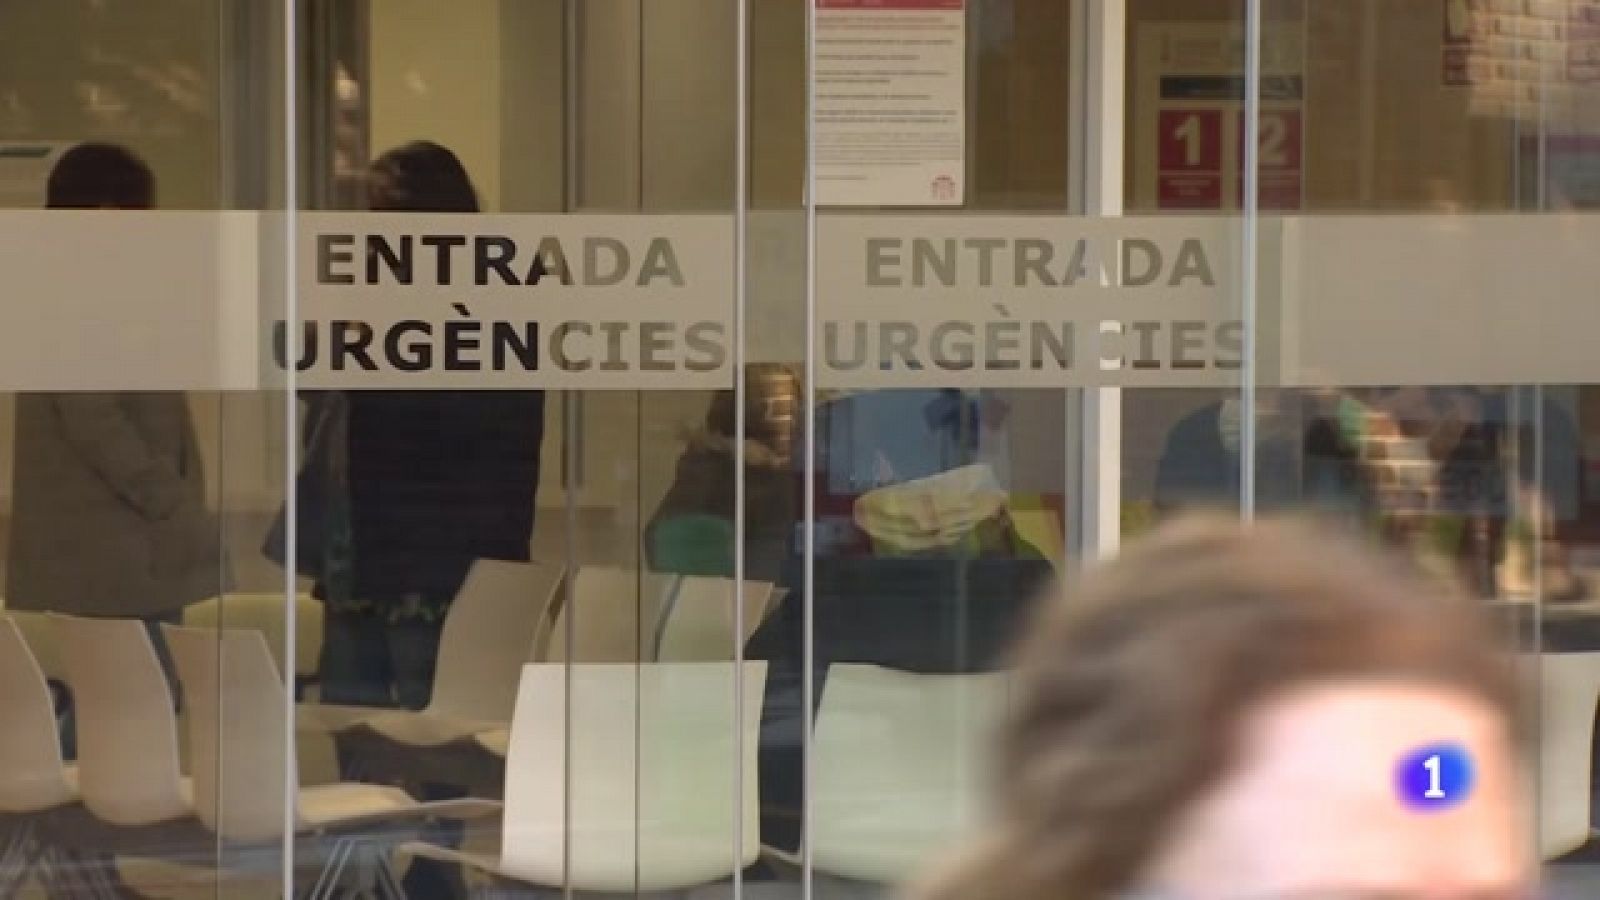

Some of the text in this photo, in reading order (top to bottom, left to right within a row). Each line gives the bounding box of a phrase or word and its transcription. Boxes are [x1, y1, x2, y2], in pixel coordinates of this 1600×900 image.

[1173, 114, 1201, 166] 1
[1258, 115, 1288, 165] 2
[315, 234, 685, 286] ENTRADA
[864, 237, 1215, 287] ENTRADA
[272, 302, 727, 372] URGÈNCIES
[823, 303, 1248, 371] URGÈNCIES
